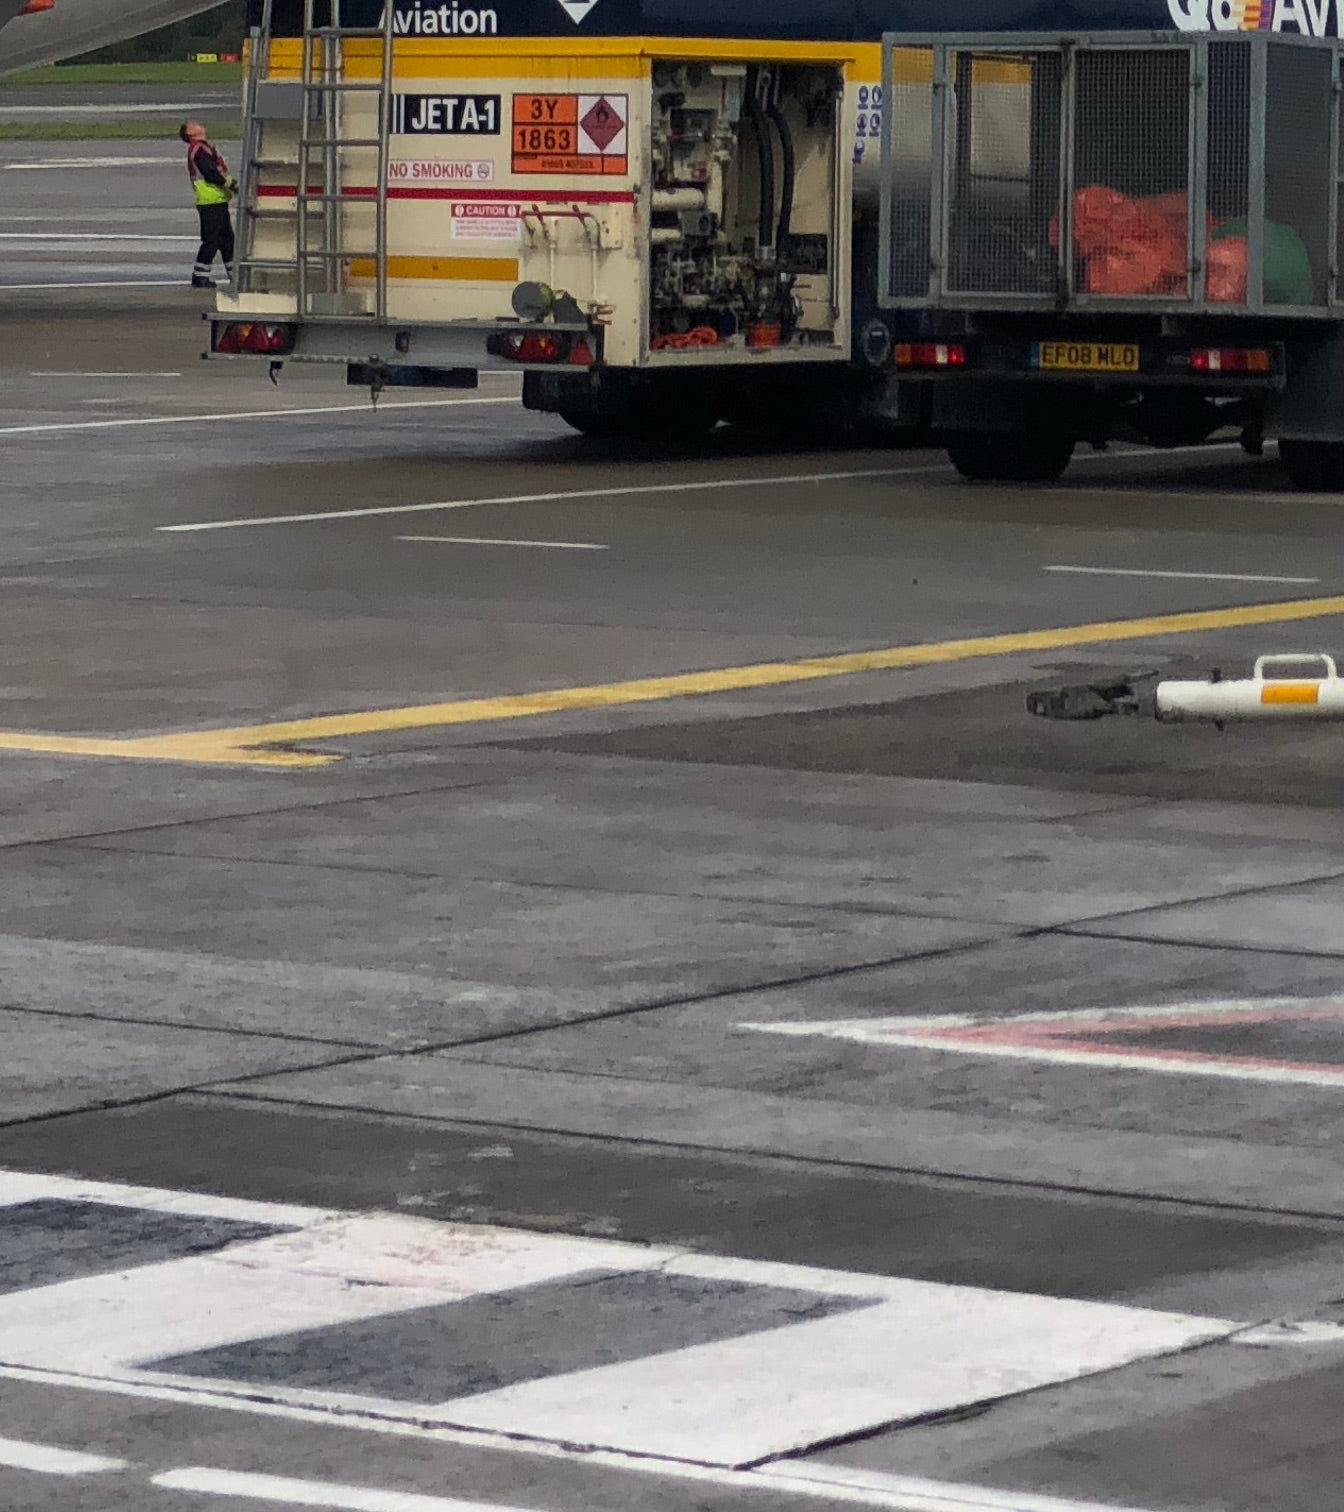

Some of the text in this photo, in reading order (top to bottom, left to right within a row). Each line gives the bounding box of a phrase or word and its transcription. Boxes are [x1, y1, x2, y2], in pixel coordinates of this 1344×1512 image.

[412, 98, 458, 131] JET
[530, 99, 558, 120] 3Y
[519, 129, 571, 150] 1863
[389, 162, 473, 178] NO SMOKING
[465, 205, 506, 216] CAUTION
[1043, 344, 1092, 365] EF08
